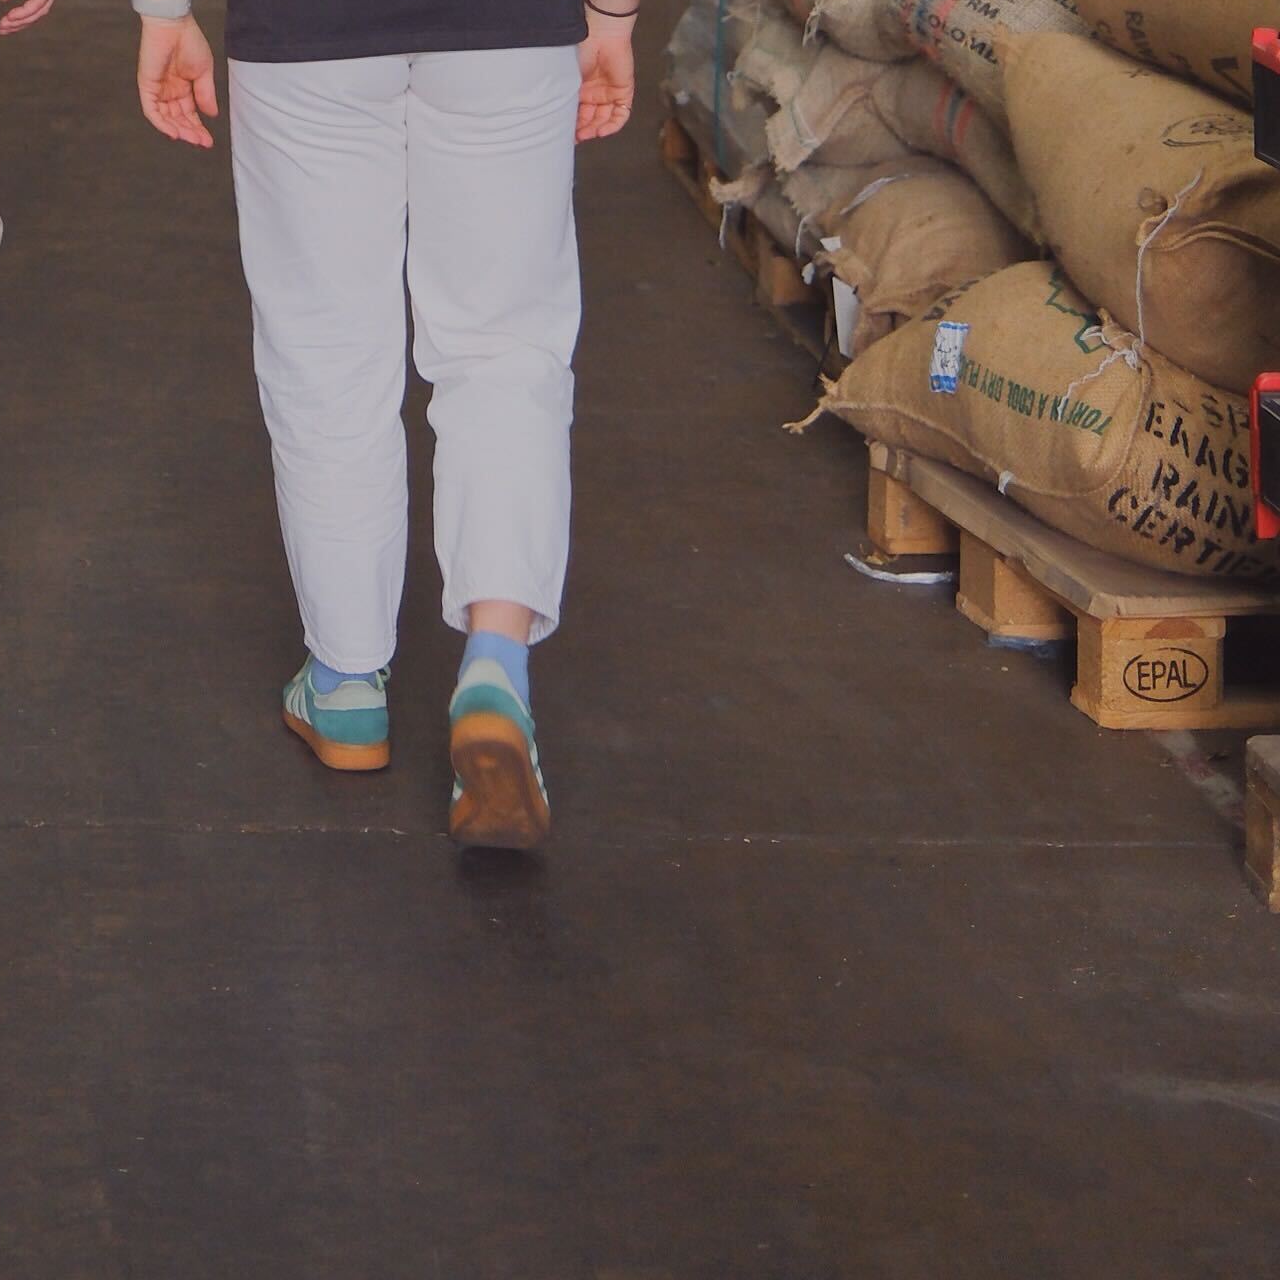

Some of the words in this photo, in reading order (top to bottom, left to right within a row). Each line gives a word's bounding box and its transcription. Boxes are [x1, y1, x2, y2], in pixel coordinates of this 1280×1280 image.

[979, 369, 1005, 403] DRY
[1007, 381, 1036, 416] COOL
[1036, 393, 1051, 420] A
[1151, 459, 1257, 544] RAIN
[1136, 659, 1198, 691] EPAL
